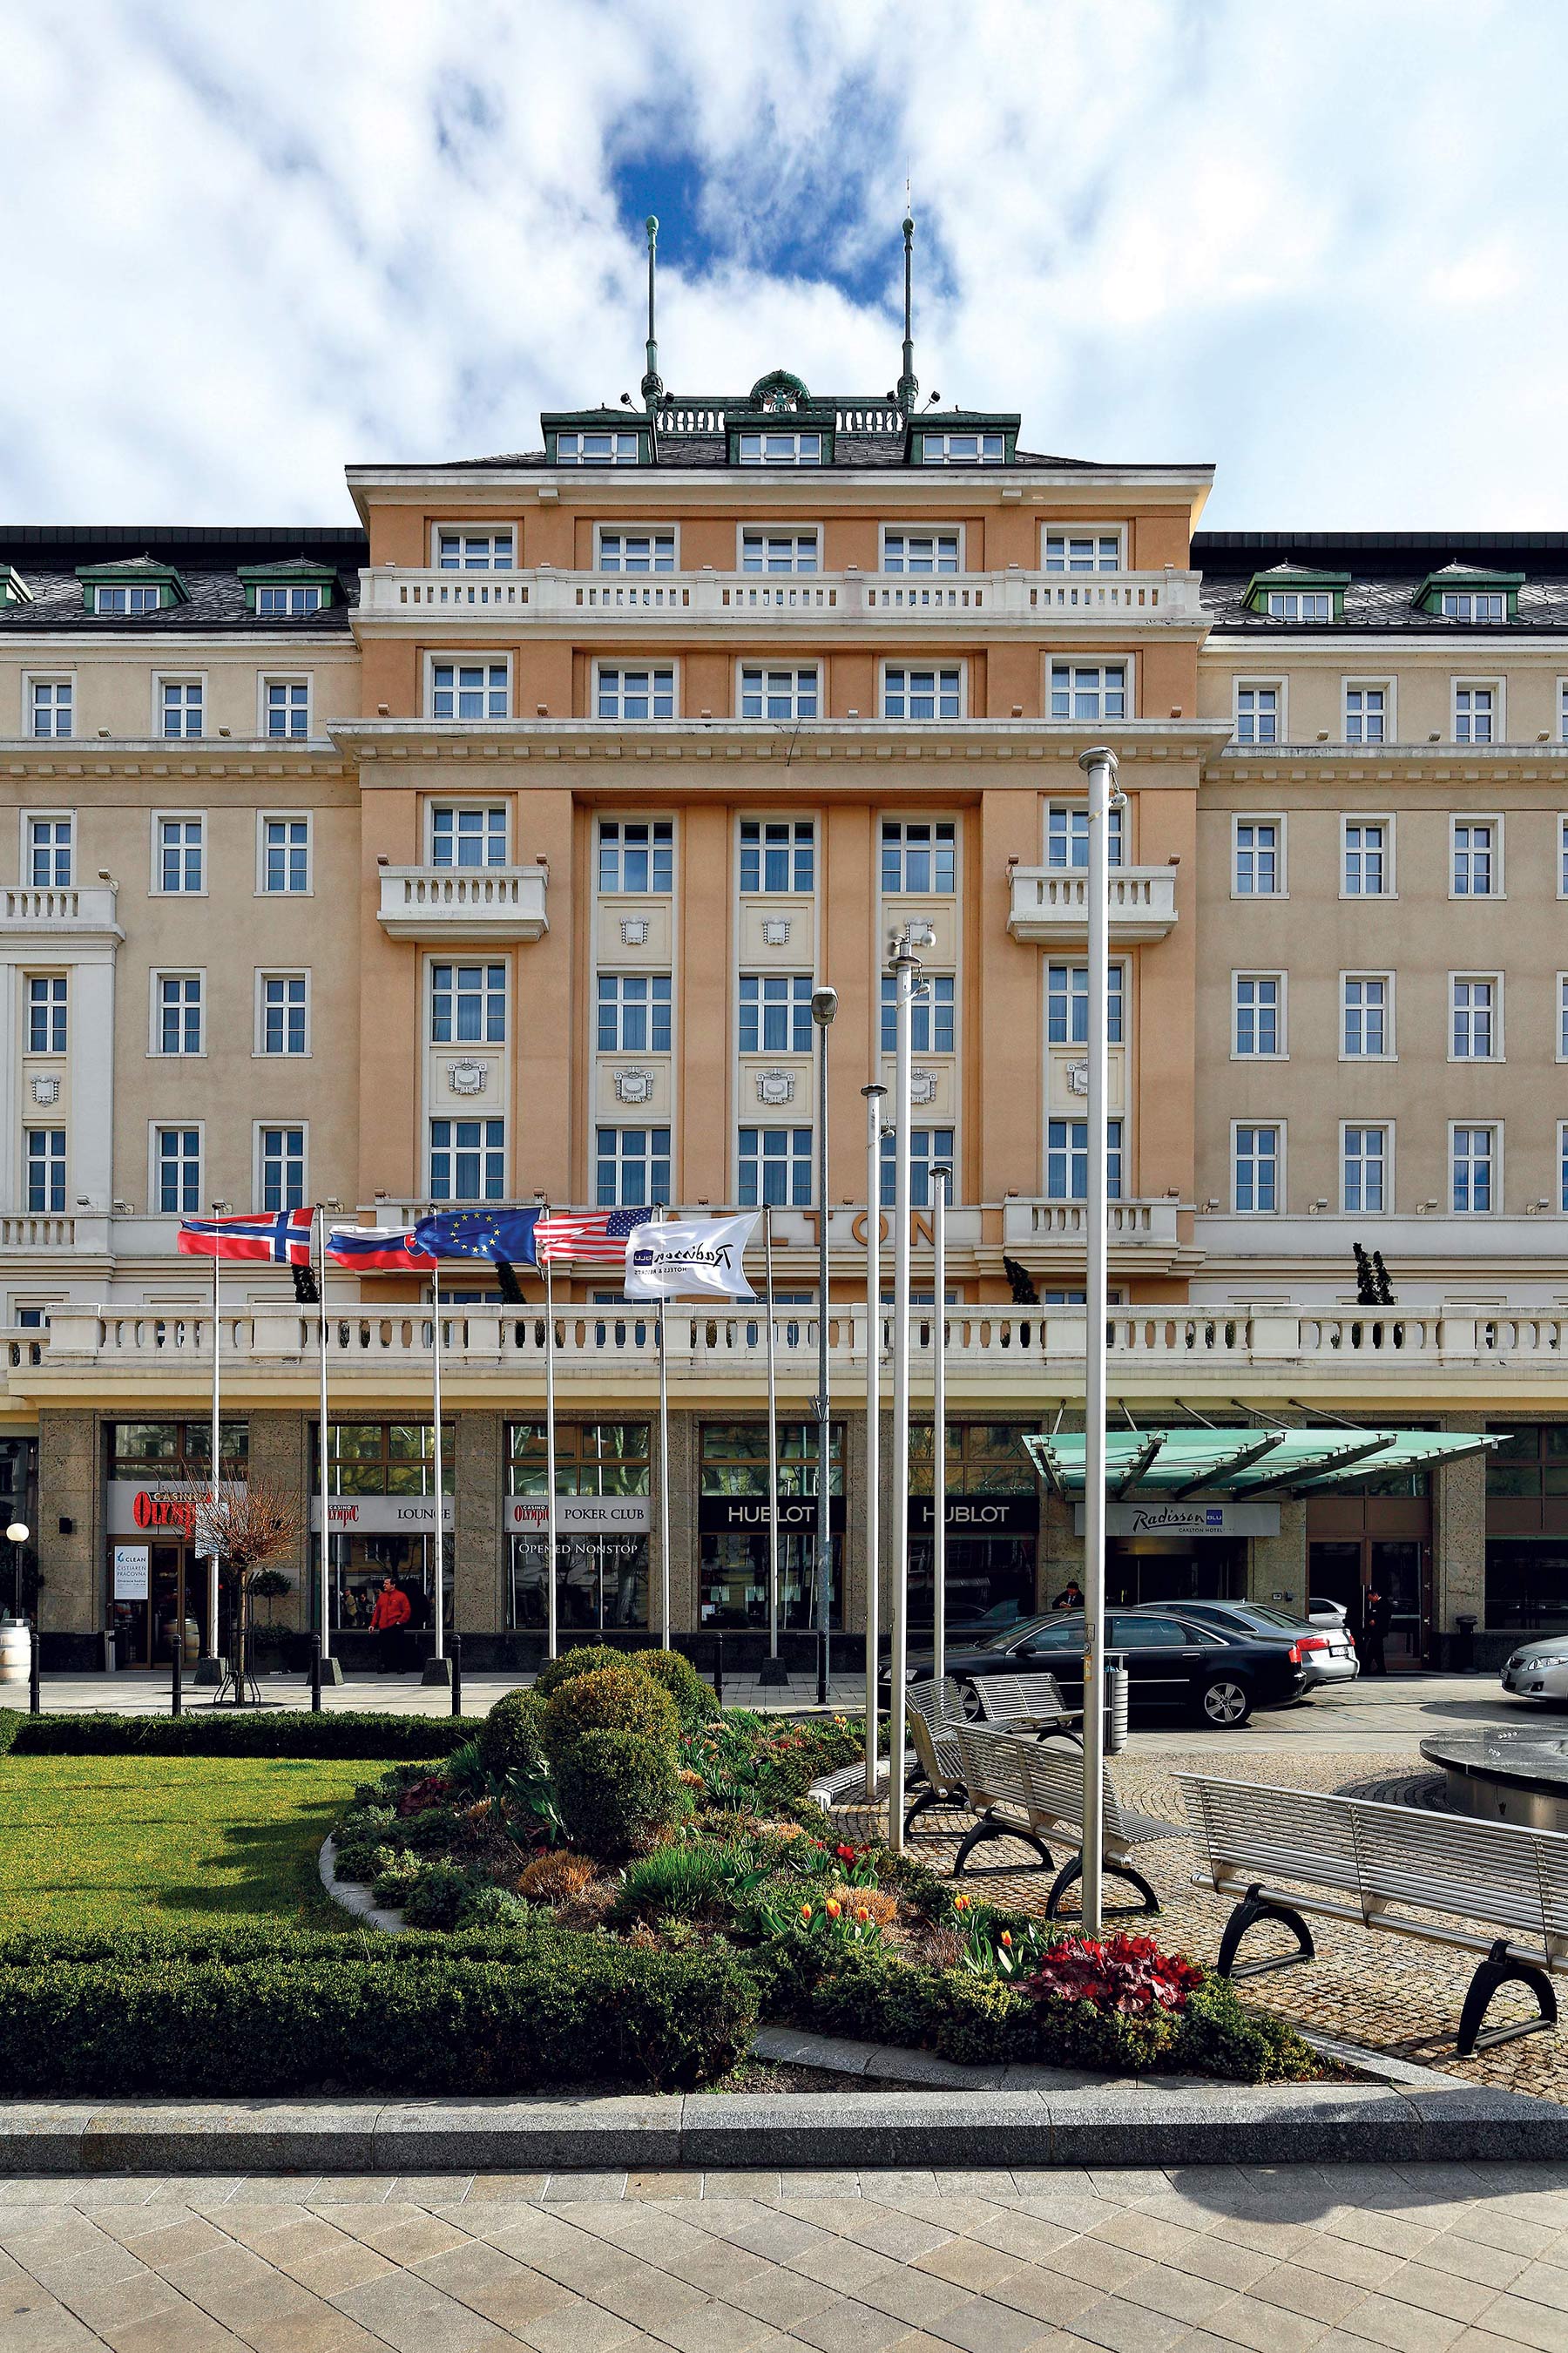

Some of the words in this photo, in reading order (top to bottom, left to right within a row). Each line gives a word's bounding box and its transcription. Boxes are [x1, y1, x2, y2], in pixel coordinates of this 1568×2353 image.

[321, 1504, 359, 1528] LYMPIC
[564, 1509, 608, 1519] POKER
[611, 1509, 645, 1519] CLUB
[1132, 1506, 1205, 1533] Radisson
[575, 1544, 638, 1554] NONSTOP
